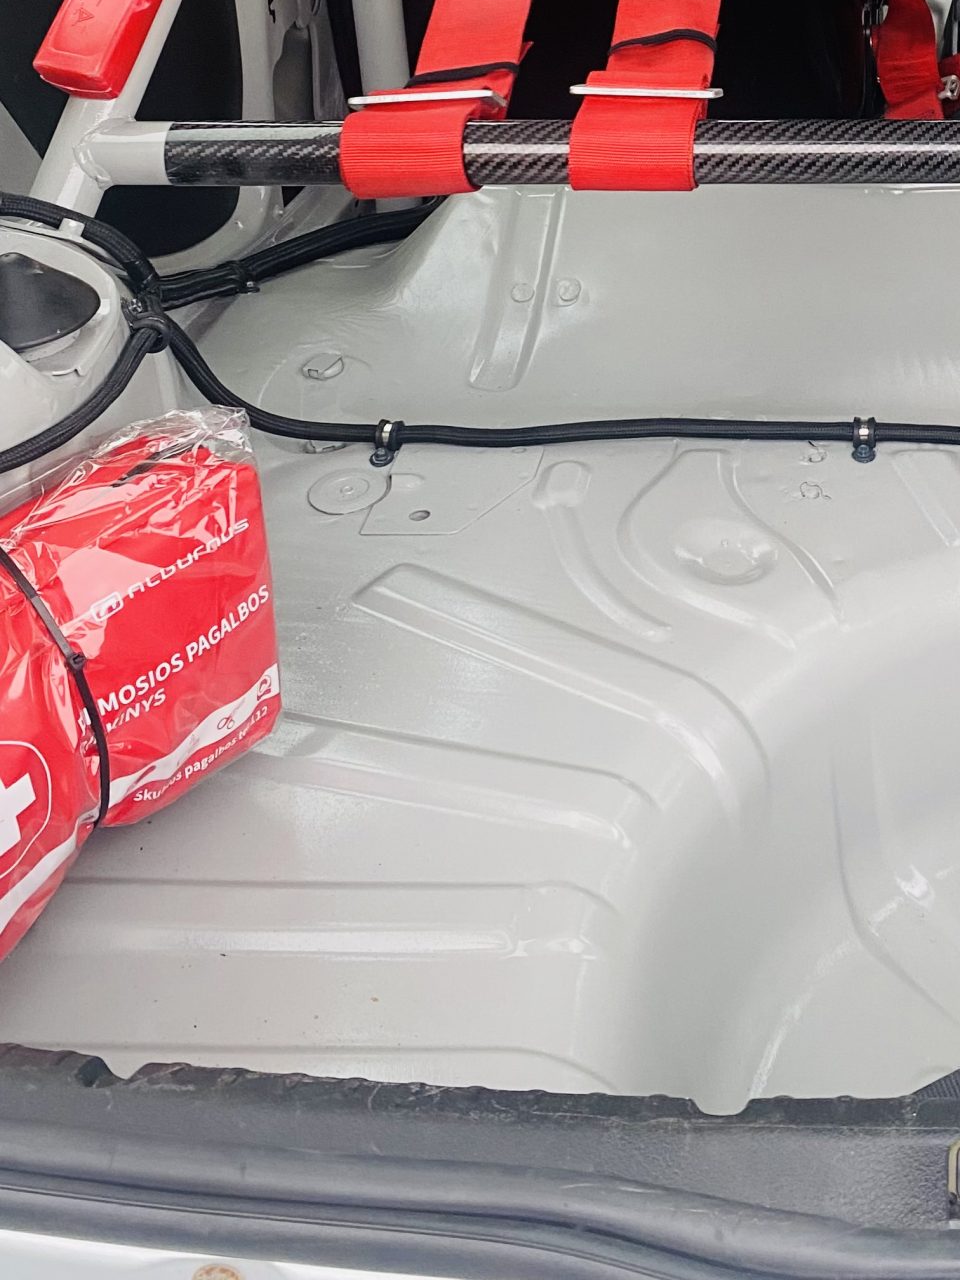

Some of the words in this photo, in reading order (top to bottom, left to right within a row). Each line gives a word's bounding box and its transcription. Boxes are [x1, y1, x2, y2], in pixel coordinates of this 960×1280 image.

[185, 584, 270, 663] PAGALBOS
[184, 736, 238, 780] pagalbos
[250, 705, 268, 726] 112
